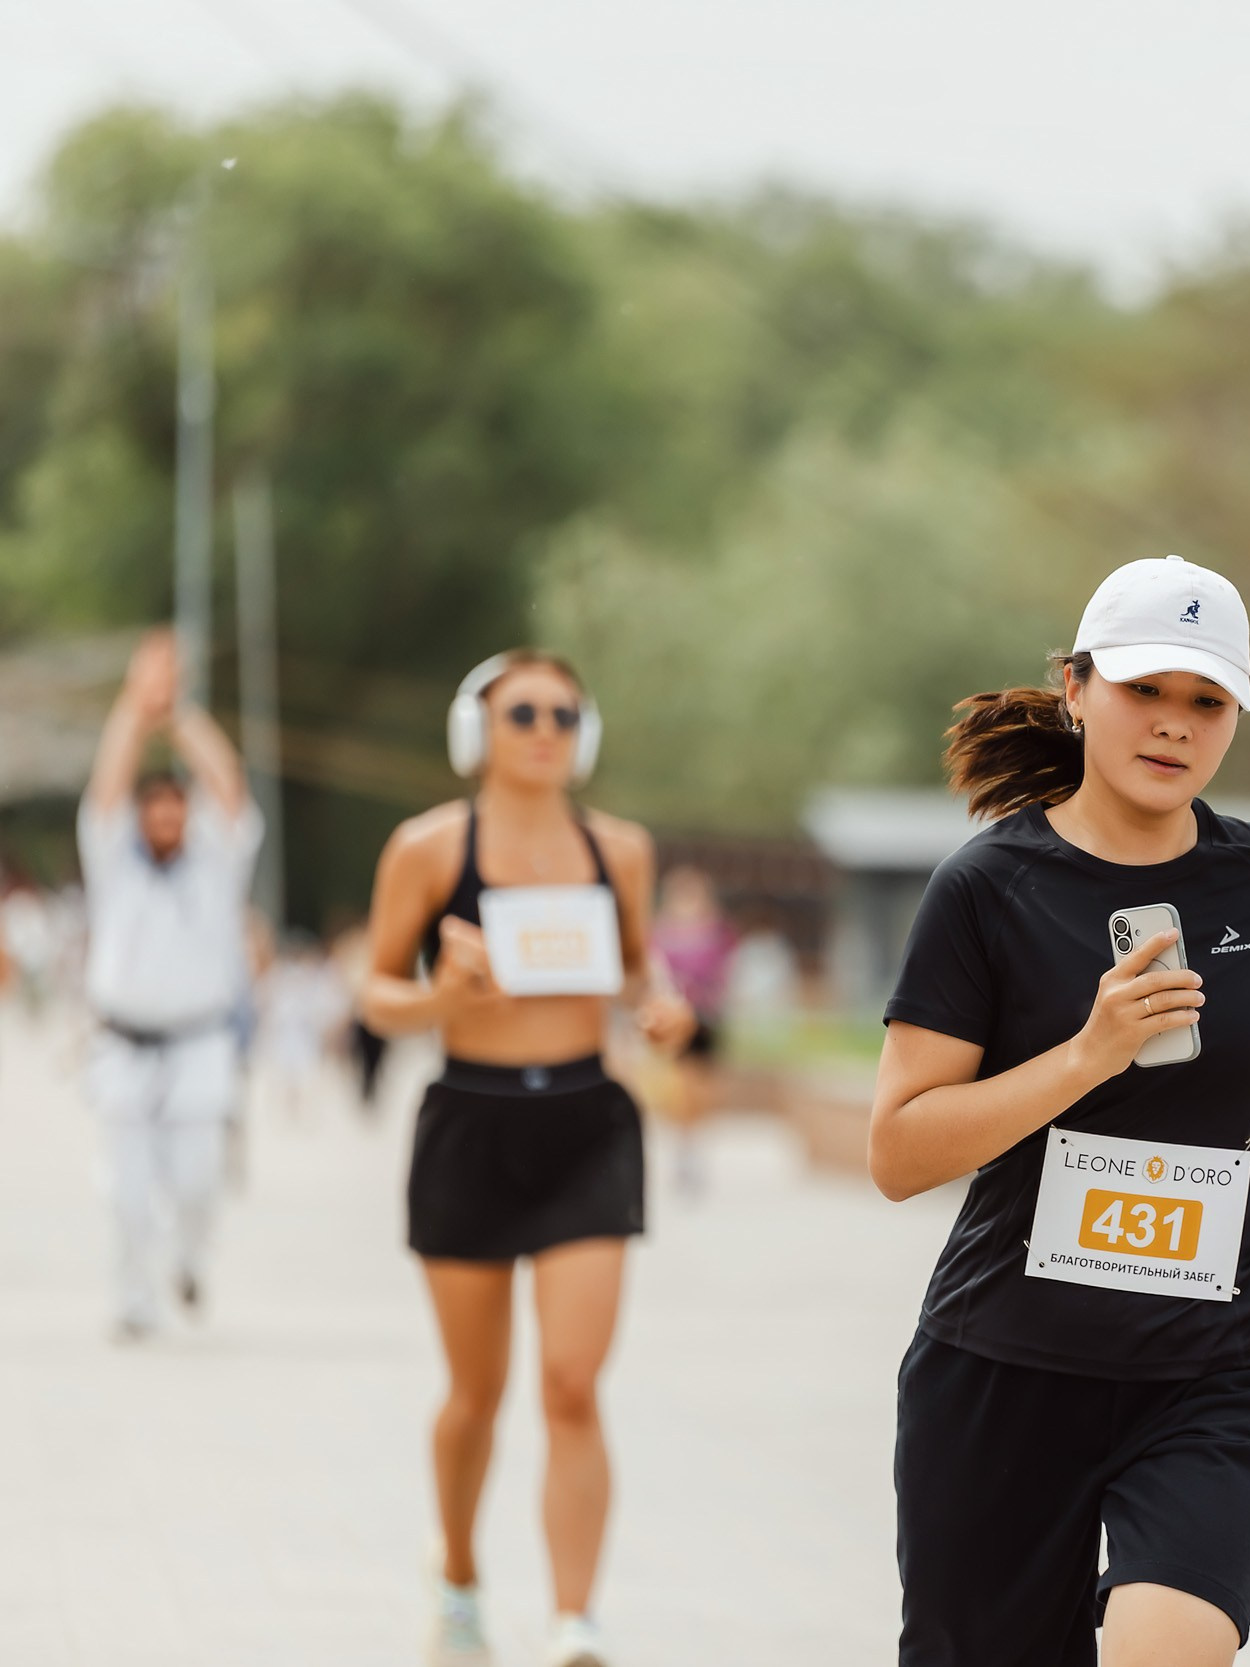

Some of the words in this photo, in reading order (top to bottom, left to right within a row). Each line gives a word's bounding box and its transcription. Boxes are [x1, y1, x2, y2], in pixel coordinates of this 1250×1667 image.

[1064, 1151, 1137, 1177] LEONE
[1173, 1165, 1232, 1186] D'ORO
[1091, 1199, 1185, 1252] 431
[1050, 1253, 1181, 1280] БЛАГОТВОРИТЕЛЬНЫЙ
[1183, 1270, 1216, 1283] ЗАБЕГ
